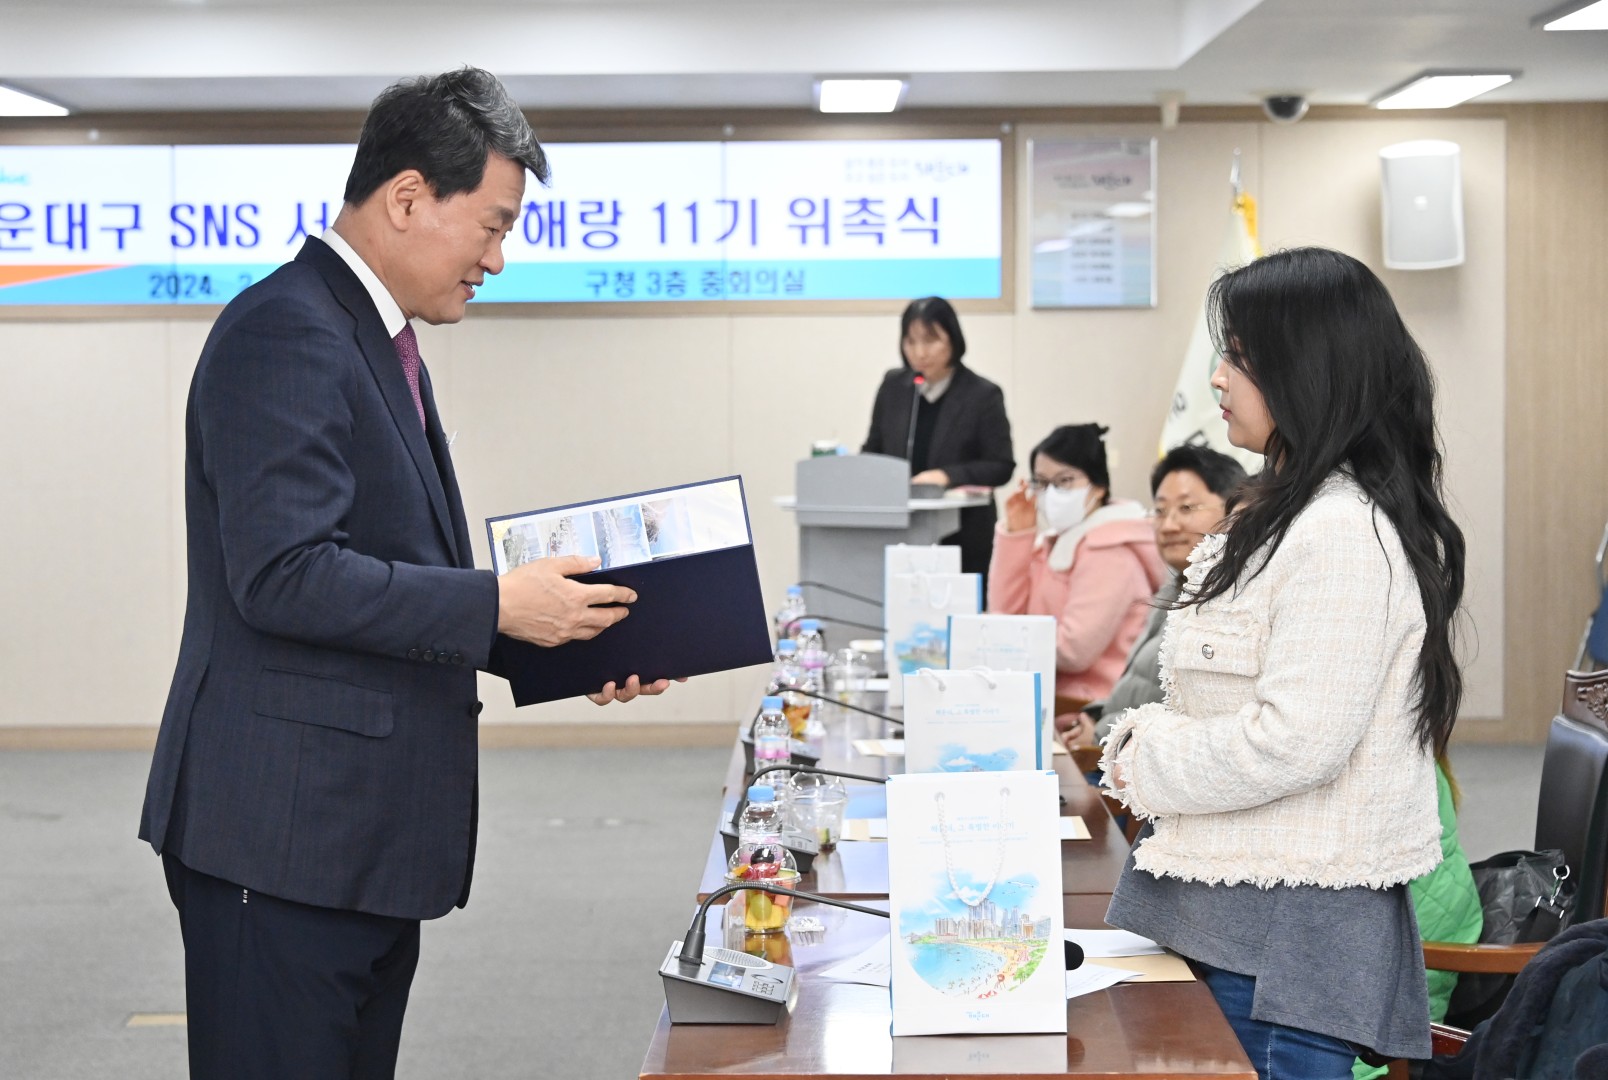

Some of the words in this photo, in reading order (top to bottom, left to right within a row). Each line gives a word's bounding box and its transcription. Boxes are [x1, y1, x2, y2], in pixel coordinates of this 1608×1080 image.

[169, 203, 260, 248] SNS
[522, 199, 624, 249] 해랑
[653, 198, 757, 247] 11기
[787, 197, 940, 246] 위촉식
[586, 269, 635, 298] 구청
[646, 269, 687, 298] 3층
[702, 268, 805, 298] 중회의실
